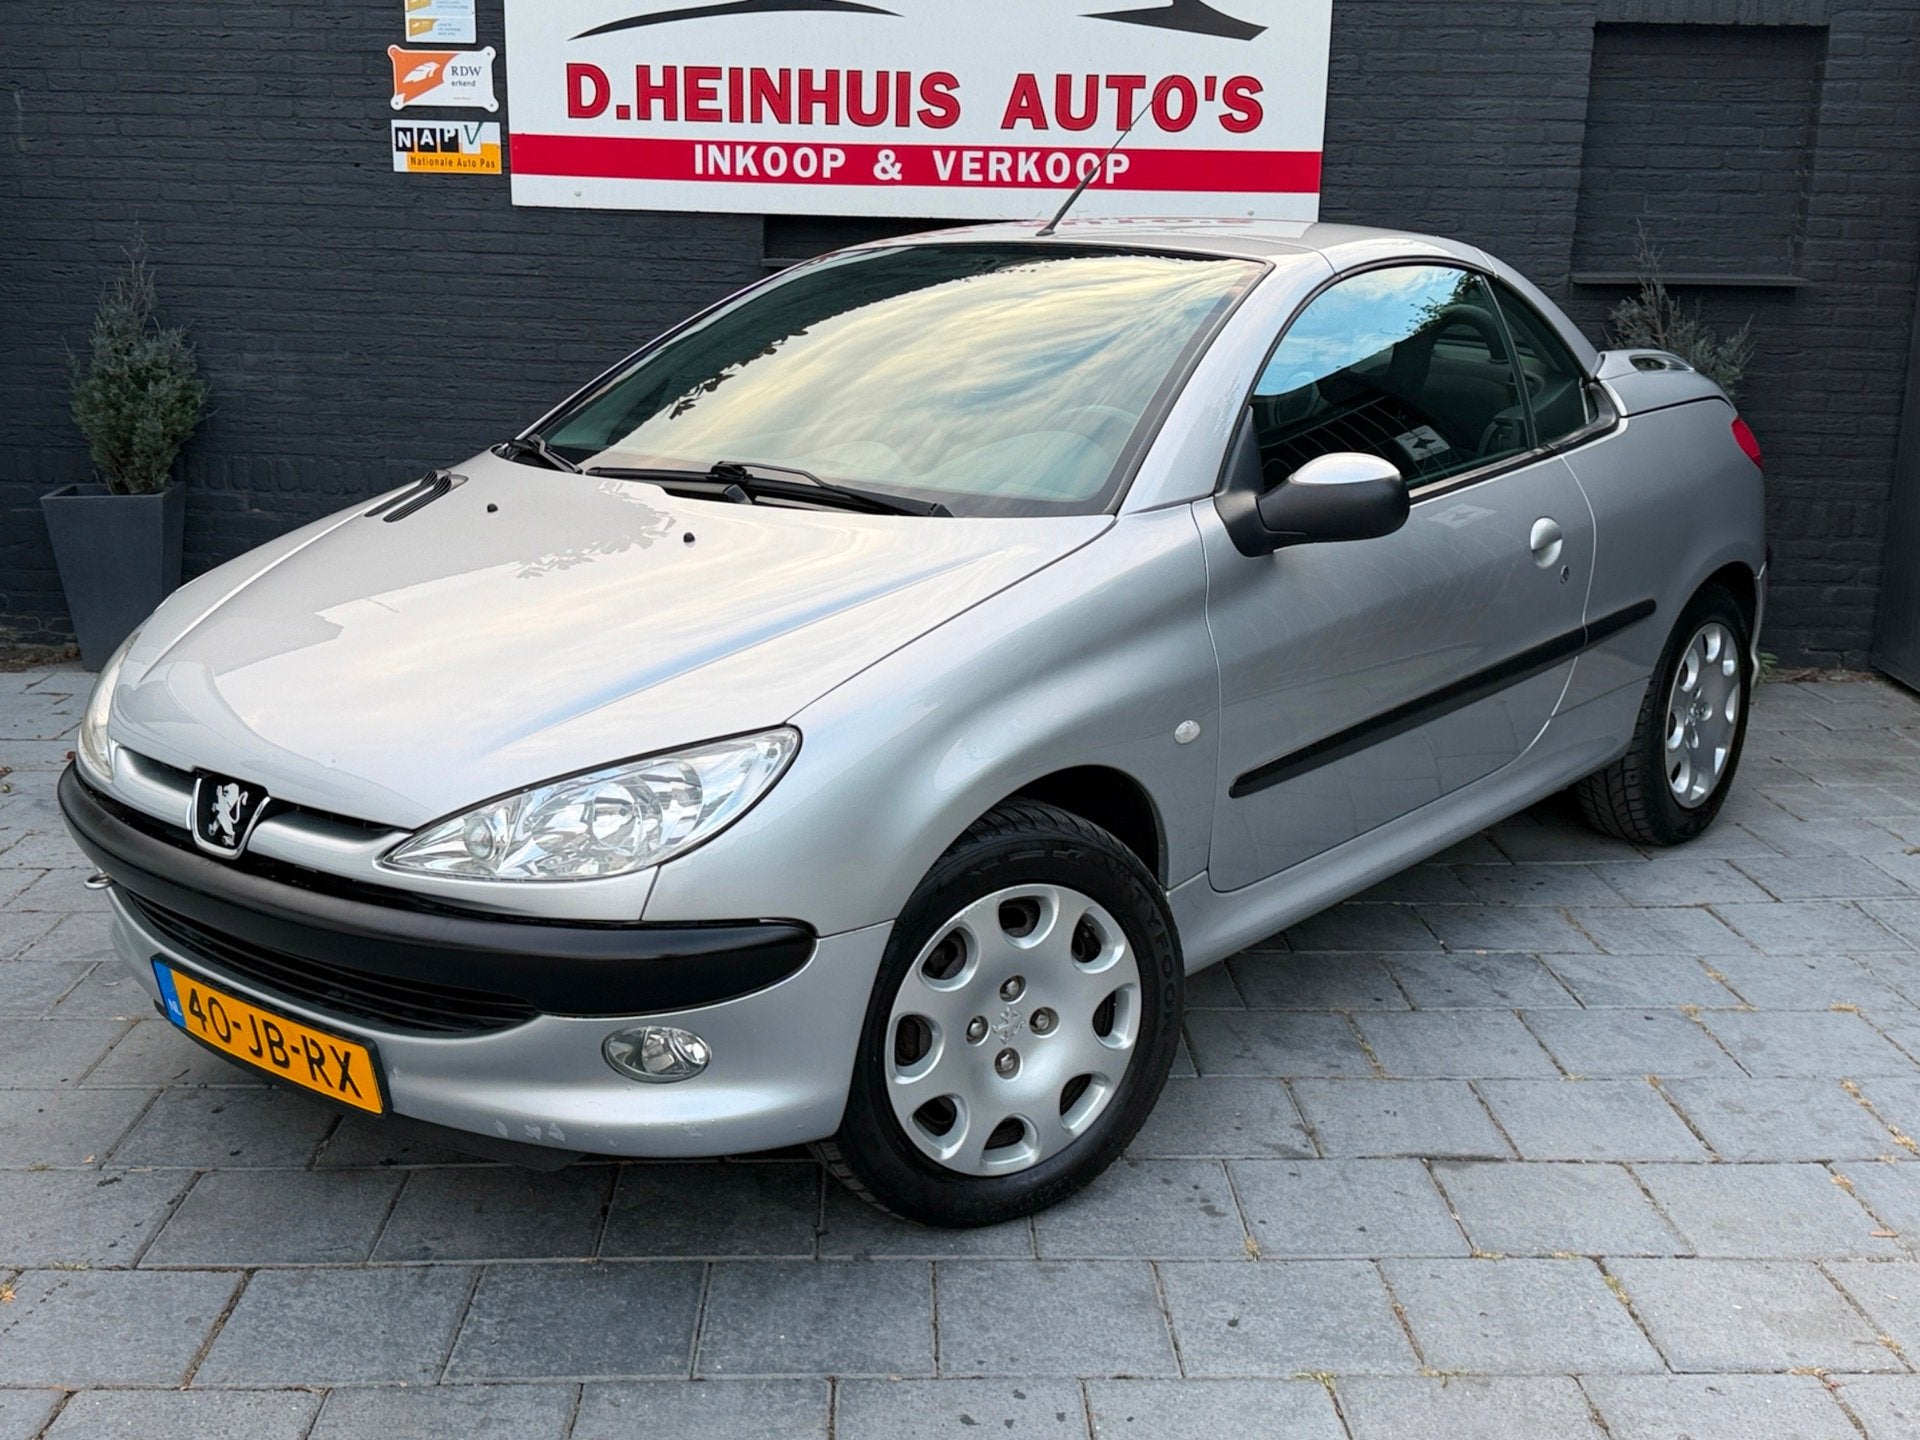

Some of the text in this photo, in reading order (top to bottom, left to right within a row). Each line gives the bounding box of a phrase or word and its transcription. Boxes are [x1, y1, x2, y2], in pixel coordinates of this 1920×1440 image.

[451, 66, 481, 76] RDW
[566, 62, 1264, 133] D.HEINHUIS AUTO'S
[410, 157, 496, 169] Nationale Auto Pas
[694, 144, 1130, 184] INKOOP & VERKOOP
[188, 987, 363, 1099] 40-JB-RX
